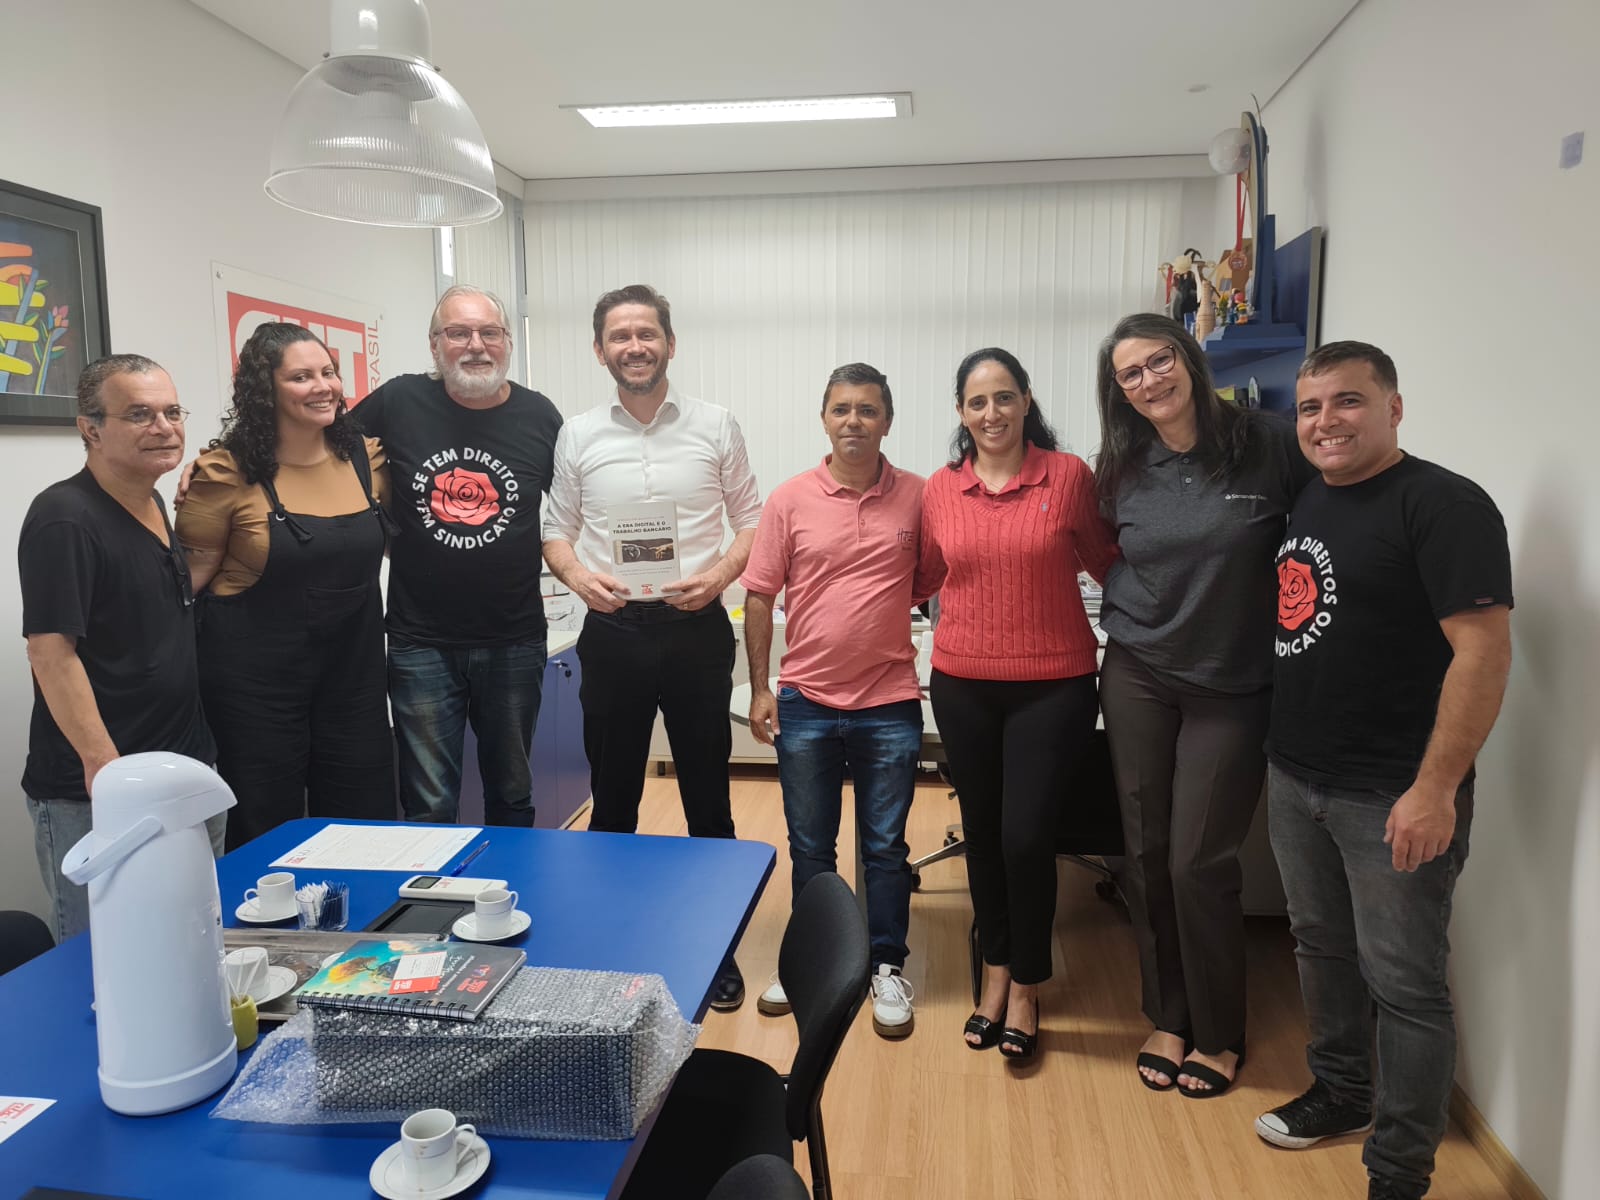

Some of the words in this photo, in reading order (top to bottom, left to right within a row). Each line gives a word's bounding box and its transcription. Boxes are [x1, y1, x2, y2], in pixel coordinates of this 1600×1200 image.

[412, 472, 429, 493] SE
[422, 448, 459, 472] TEM
[463, 447, 519, 502] DIREITOS
[416, 498, 436, 528] TEM
[433, 507, 516, 549] SINDICATO
[1275, 537, 1298, 562] EM
[1299, 536, 1338, 605] DIREITOS
